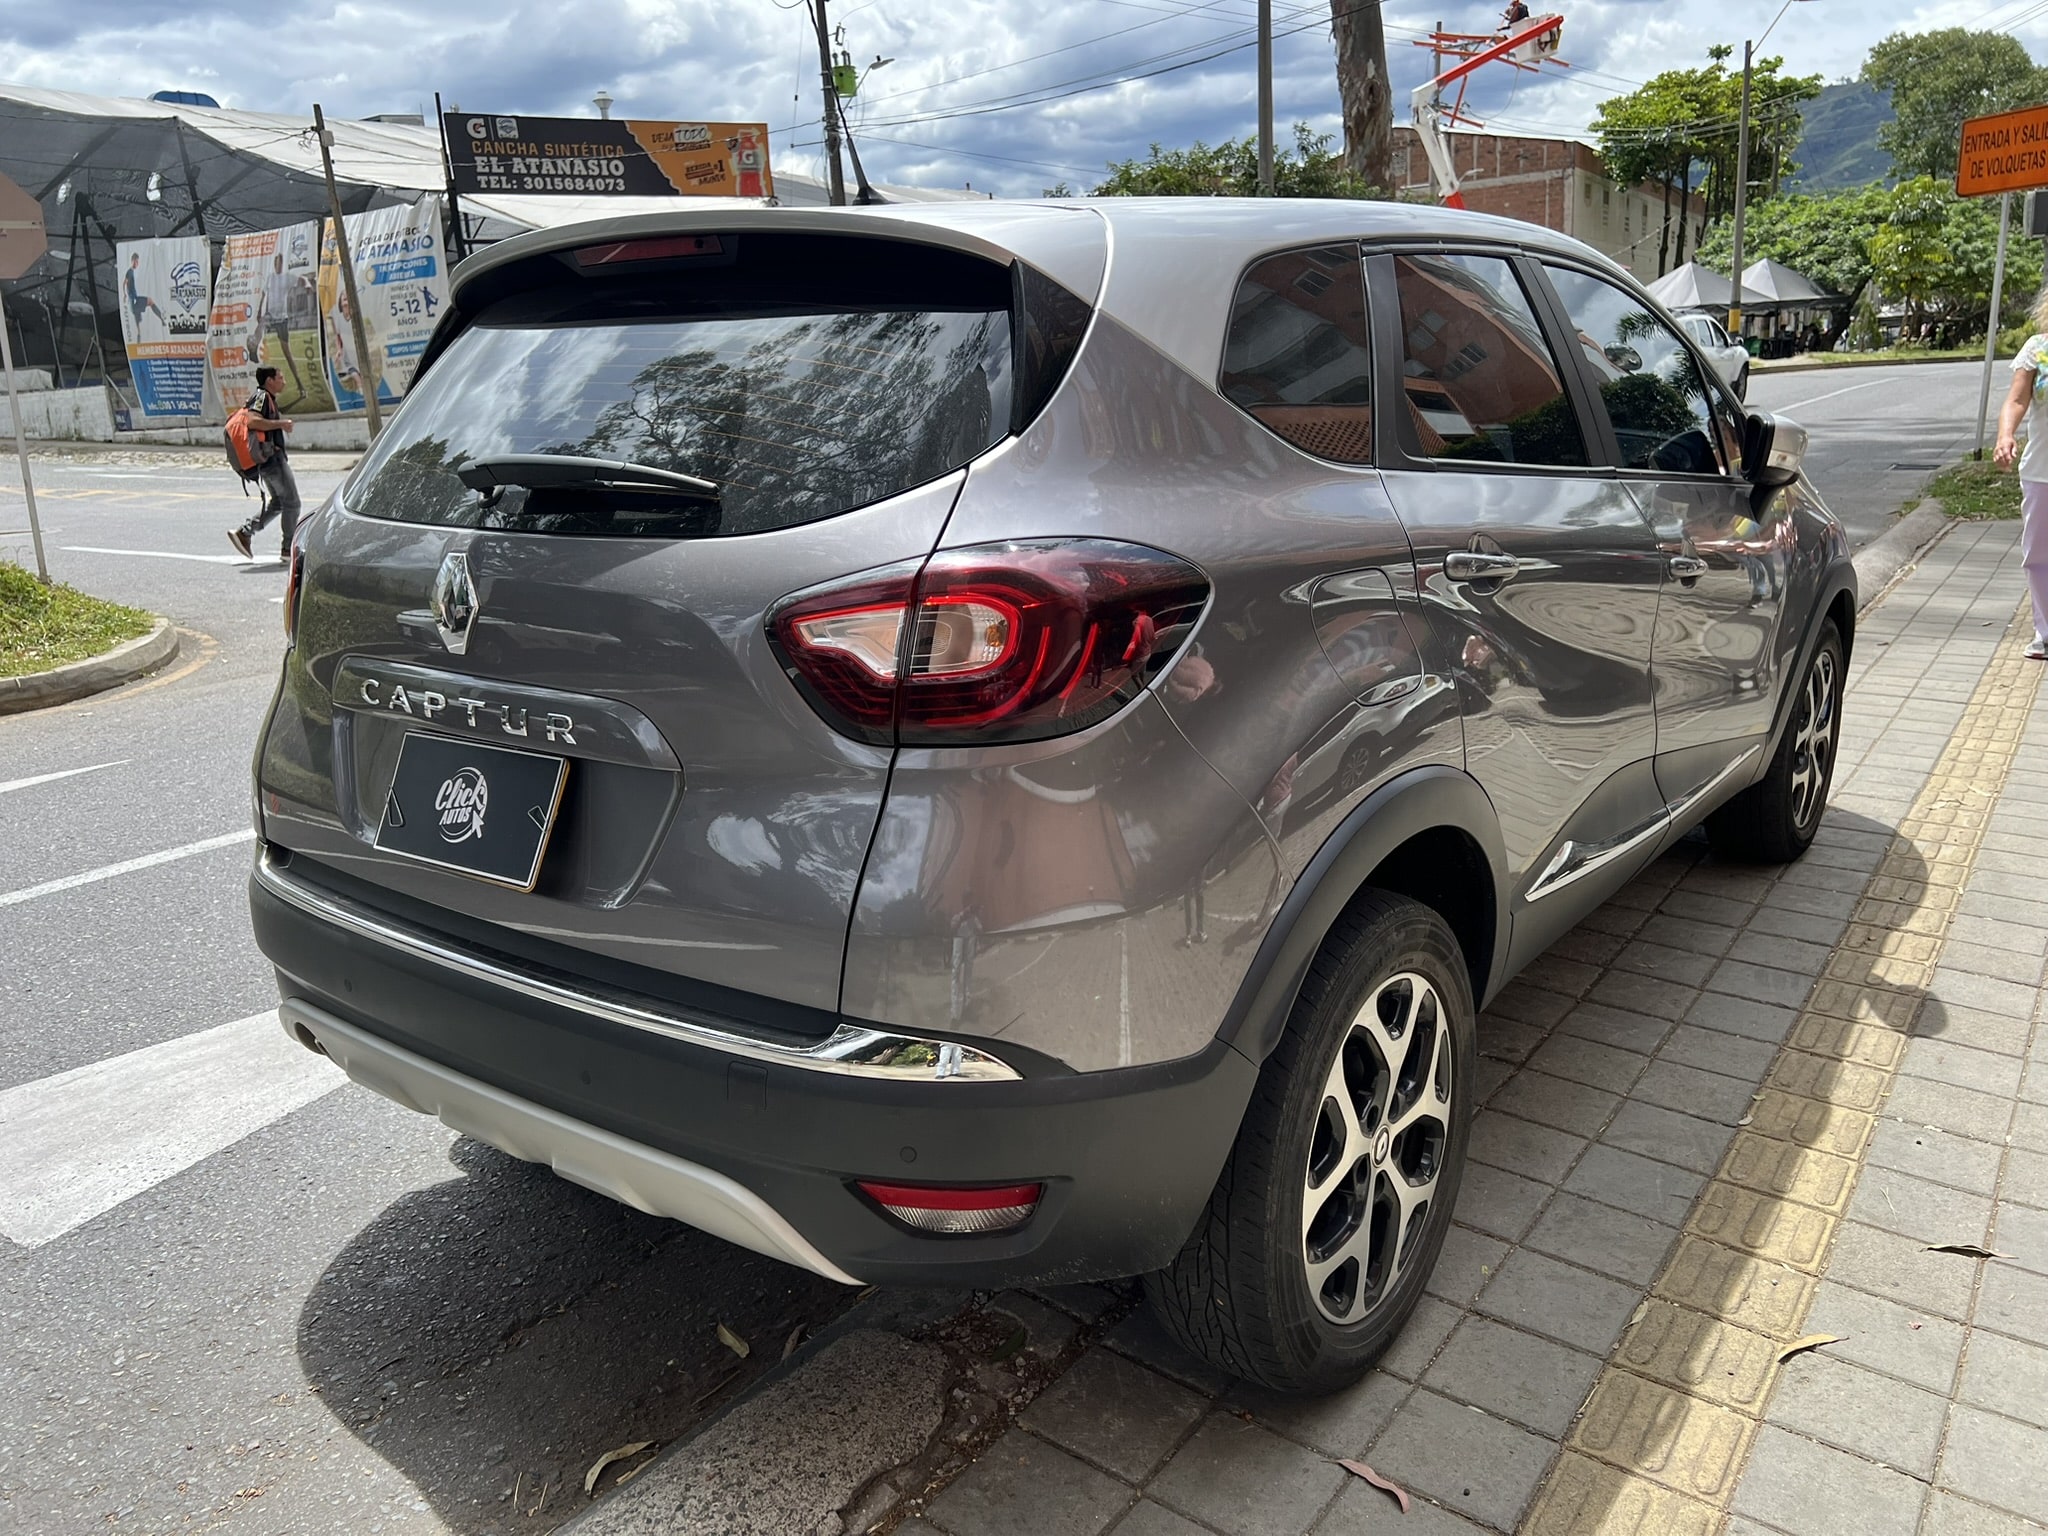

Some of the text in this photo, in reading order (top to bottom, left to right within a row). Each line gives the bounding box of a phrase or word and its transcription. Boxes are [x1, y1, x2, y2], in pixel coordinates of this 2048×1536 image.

[675, 128, 707, 141] TODO
[1964, 128, 2010, 154] ENTRADA
[2013, 126, 2020, 146] Y
[471, 140, 625, 158] CANCHA SINTÉTICA
[474, 156, 625, 177] EL ATANASIO
[1970, 150, 2046, 179] DE VOLQUETAS
[477, 175, 626, 192] TEL: 3015684073
[368, 235, 434, 259] ATANASIO
[390, 298, 421, 317] 5-12
[397, 317, 418, 327] AÑOS
[360, 678, 577, 745] CAPTUR
